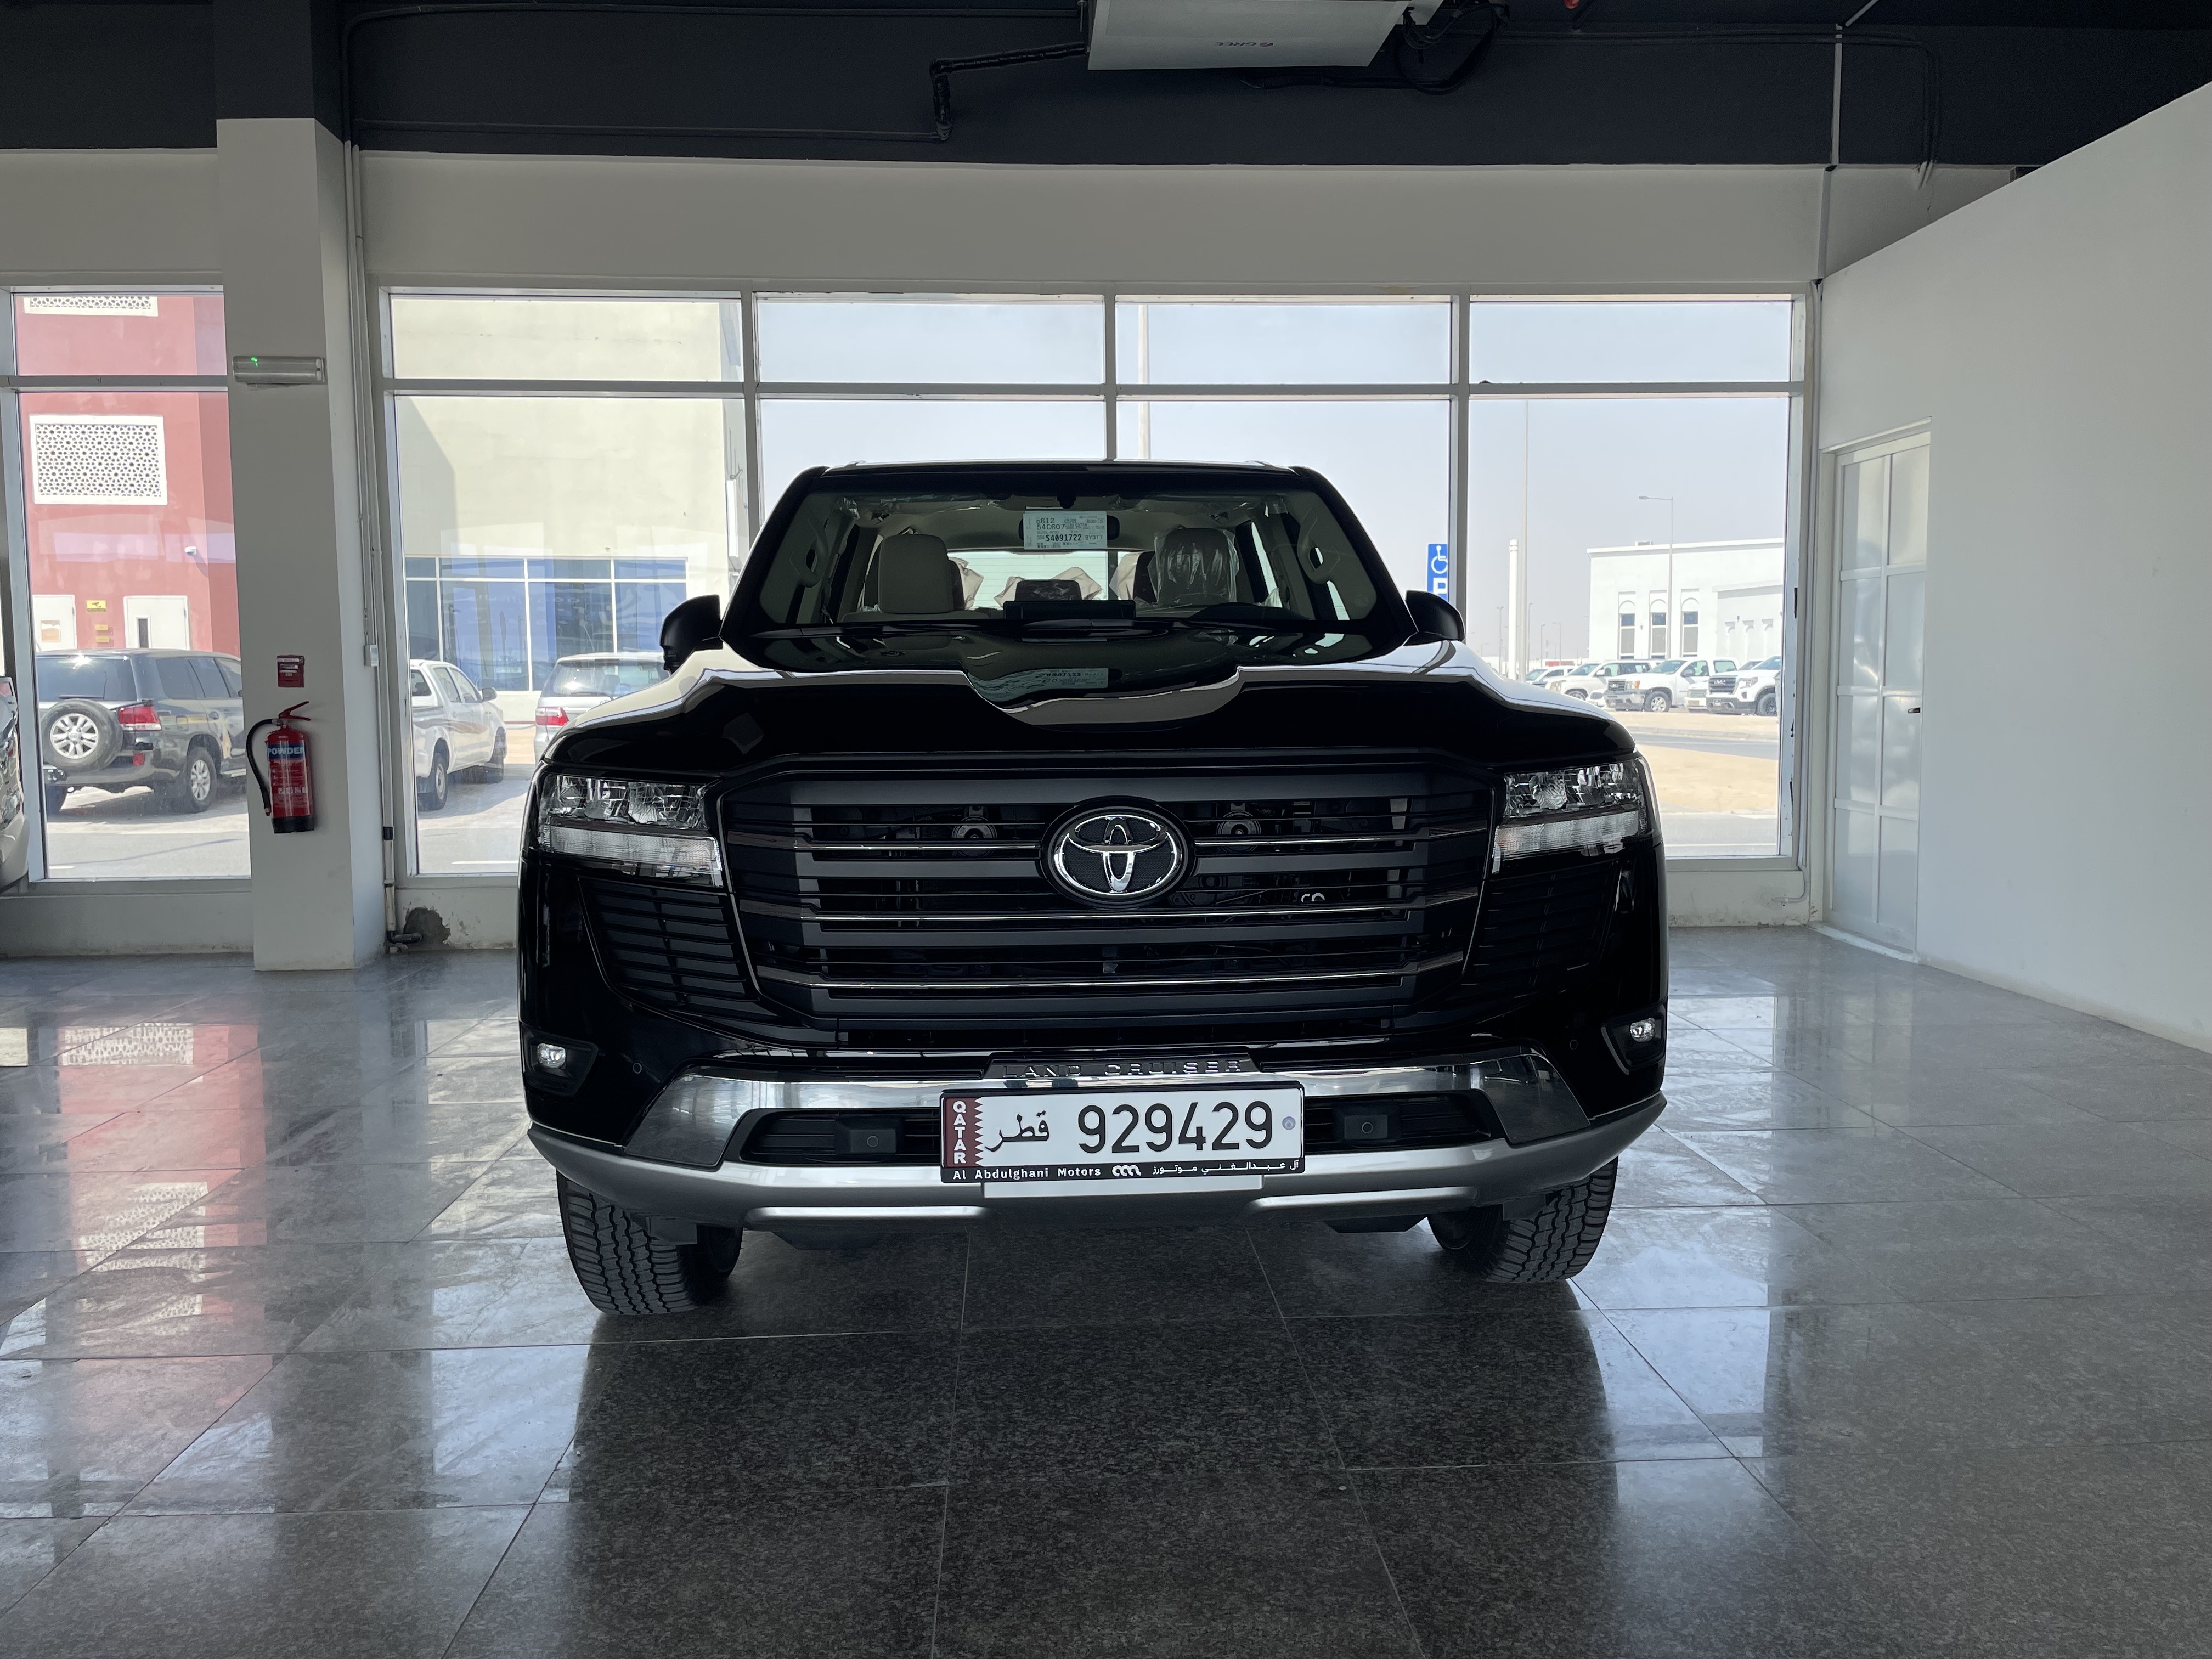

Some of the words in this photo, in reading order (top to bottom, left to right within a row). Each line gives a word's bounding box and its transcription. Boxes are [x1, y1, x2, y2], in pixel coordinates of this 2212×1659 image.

[1003, 1064, 1082, 1078] LAND
[1104, 1060, 1242, 1075] CRUISER
[953, 1101, 967, 1164] QATAR
[984, 1110, 1049, 1152] قطر
[1077, 1101, 1273, 1154] 929429
[953, 1170, 966, 1180] Al
[975, 1167, 1049, 1180] Abdulghani
[1057, 1167, 1101, 1177] Motors
